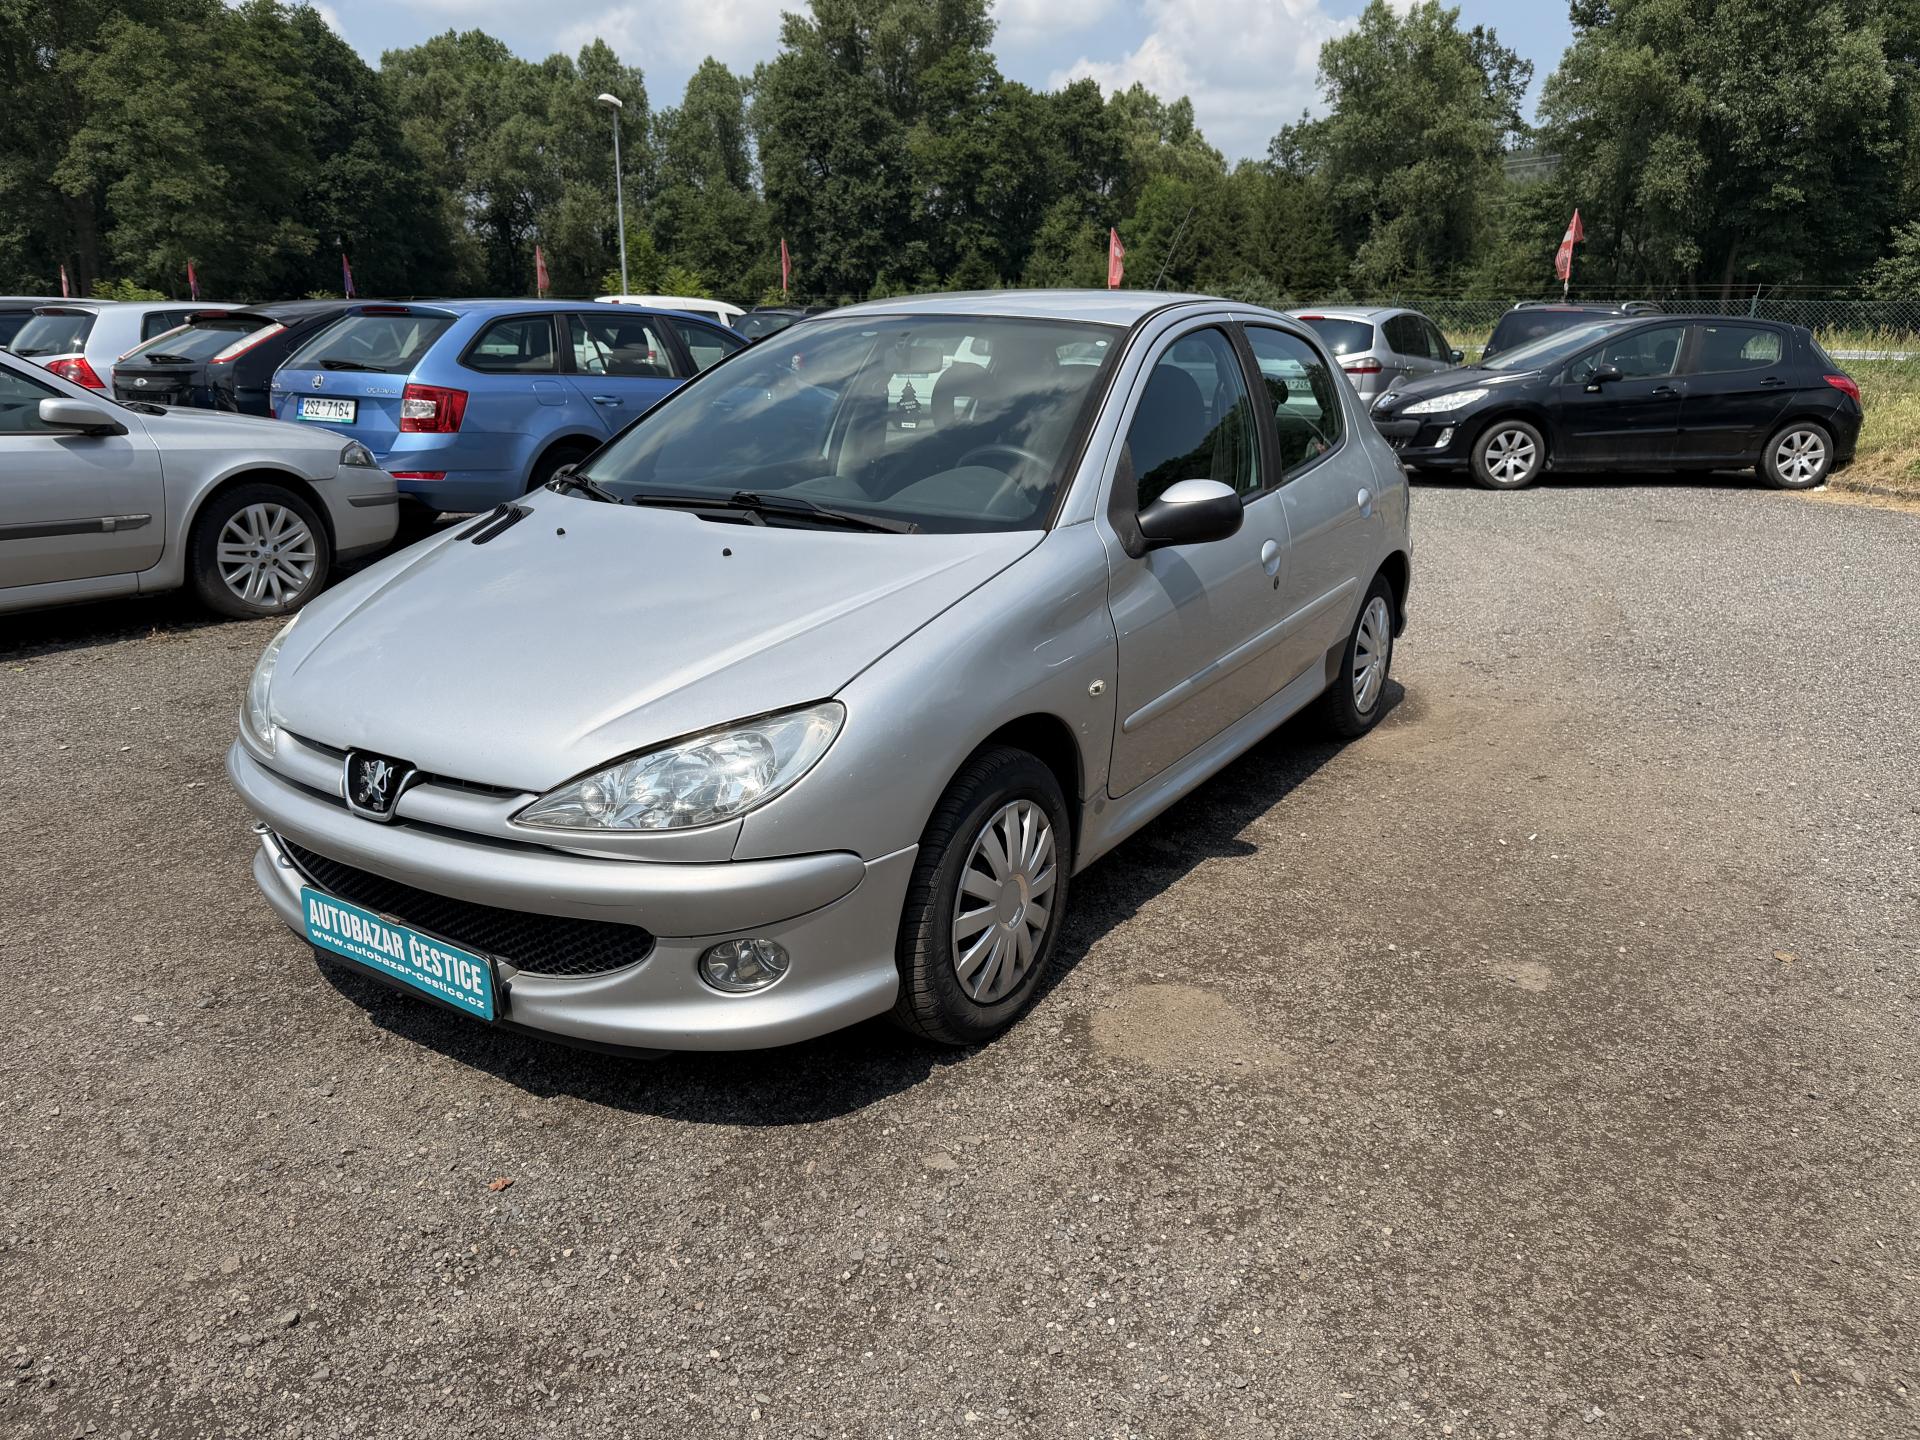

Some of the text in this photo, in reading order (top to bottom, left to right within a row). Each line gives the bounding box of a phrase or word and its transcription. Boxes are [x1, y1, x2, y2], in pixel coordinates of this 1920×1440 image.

[305, 400, 320, 415] 2SZ
[326, 401, 349, 418] 7164
[309, 898, 484, 996] AUTOBAZAR ČESTICE
[311, 928, 485, 1010] www.autobazar-cestice.cz
